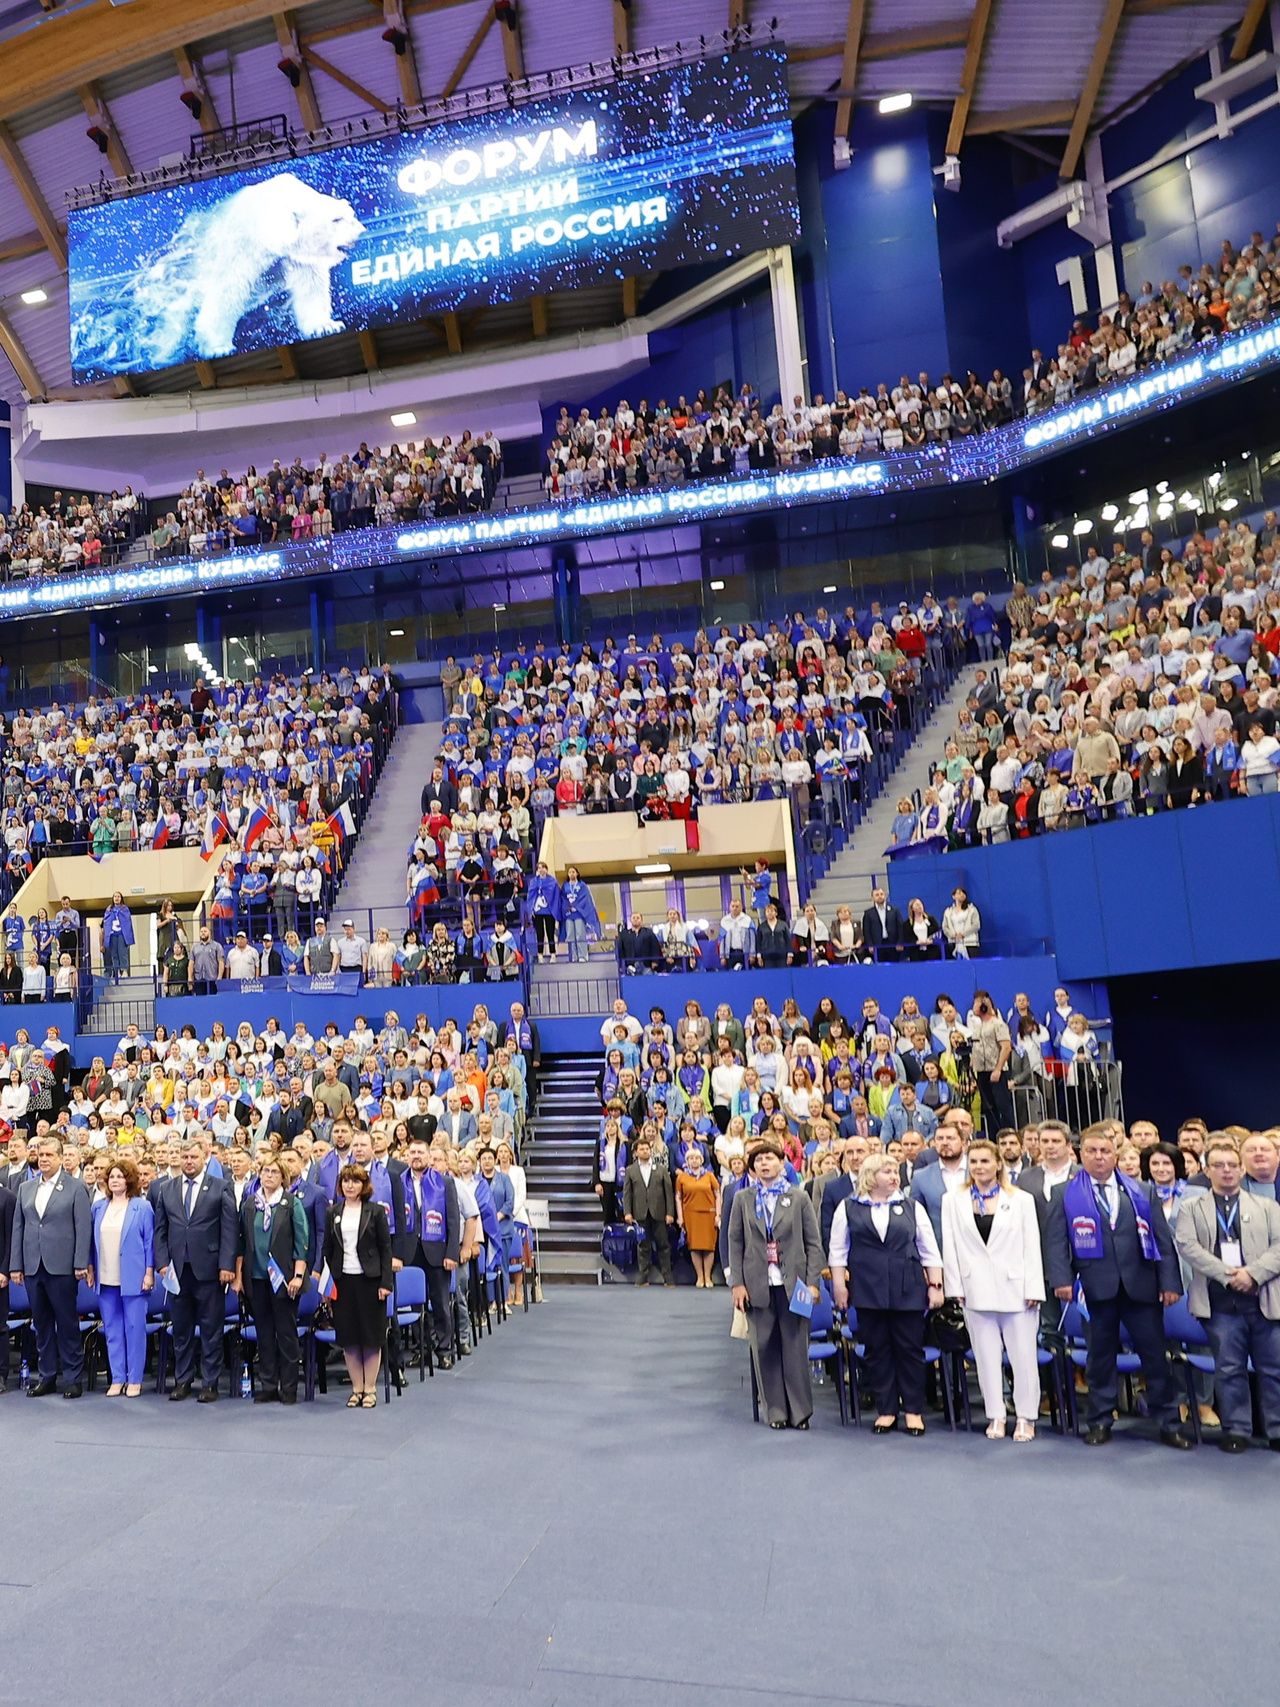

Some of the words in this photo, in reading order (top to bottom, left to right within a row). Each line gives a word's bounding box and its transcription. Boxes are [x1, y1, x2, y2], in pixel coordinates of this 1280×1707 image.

[397, 120, 598, 195] ФОРУМ
[351, 232, 501, 286] ЕДИНАЯ
[511, 196, 667, 252] РОССИЯ
[427, 178, 579, 234] ПАРТИИ
[1024, 401, 1103, 447] ФОРУМ
[1107, 360, 1203, 414] ПАРТИИ
[397, 526, 470, 549] ФОРУМ
[476, 513, 558, 539] ПАРТИИ
[562, 497, 663, 525] «ЕДИНАЯ
[669, 483, 769, 511] РОССИЯ»
[776, 465, 882, 495] КУZБАСС
[31, 579, 110, 601] «ЕДИНАЯ
[115, 567, 193, 590] РОССИЯ»
[198, 554, 280, 578] КУZБАСС
